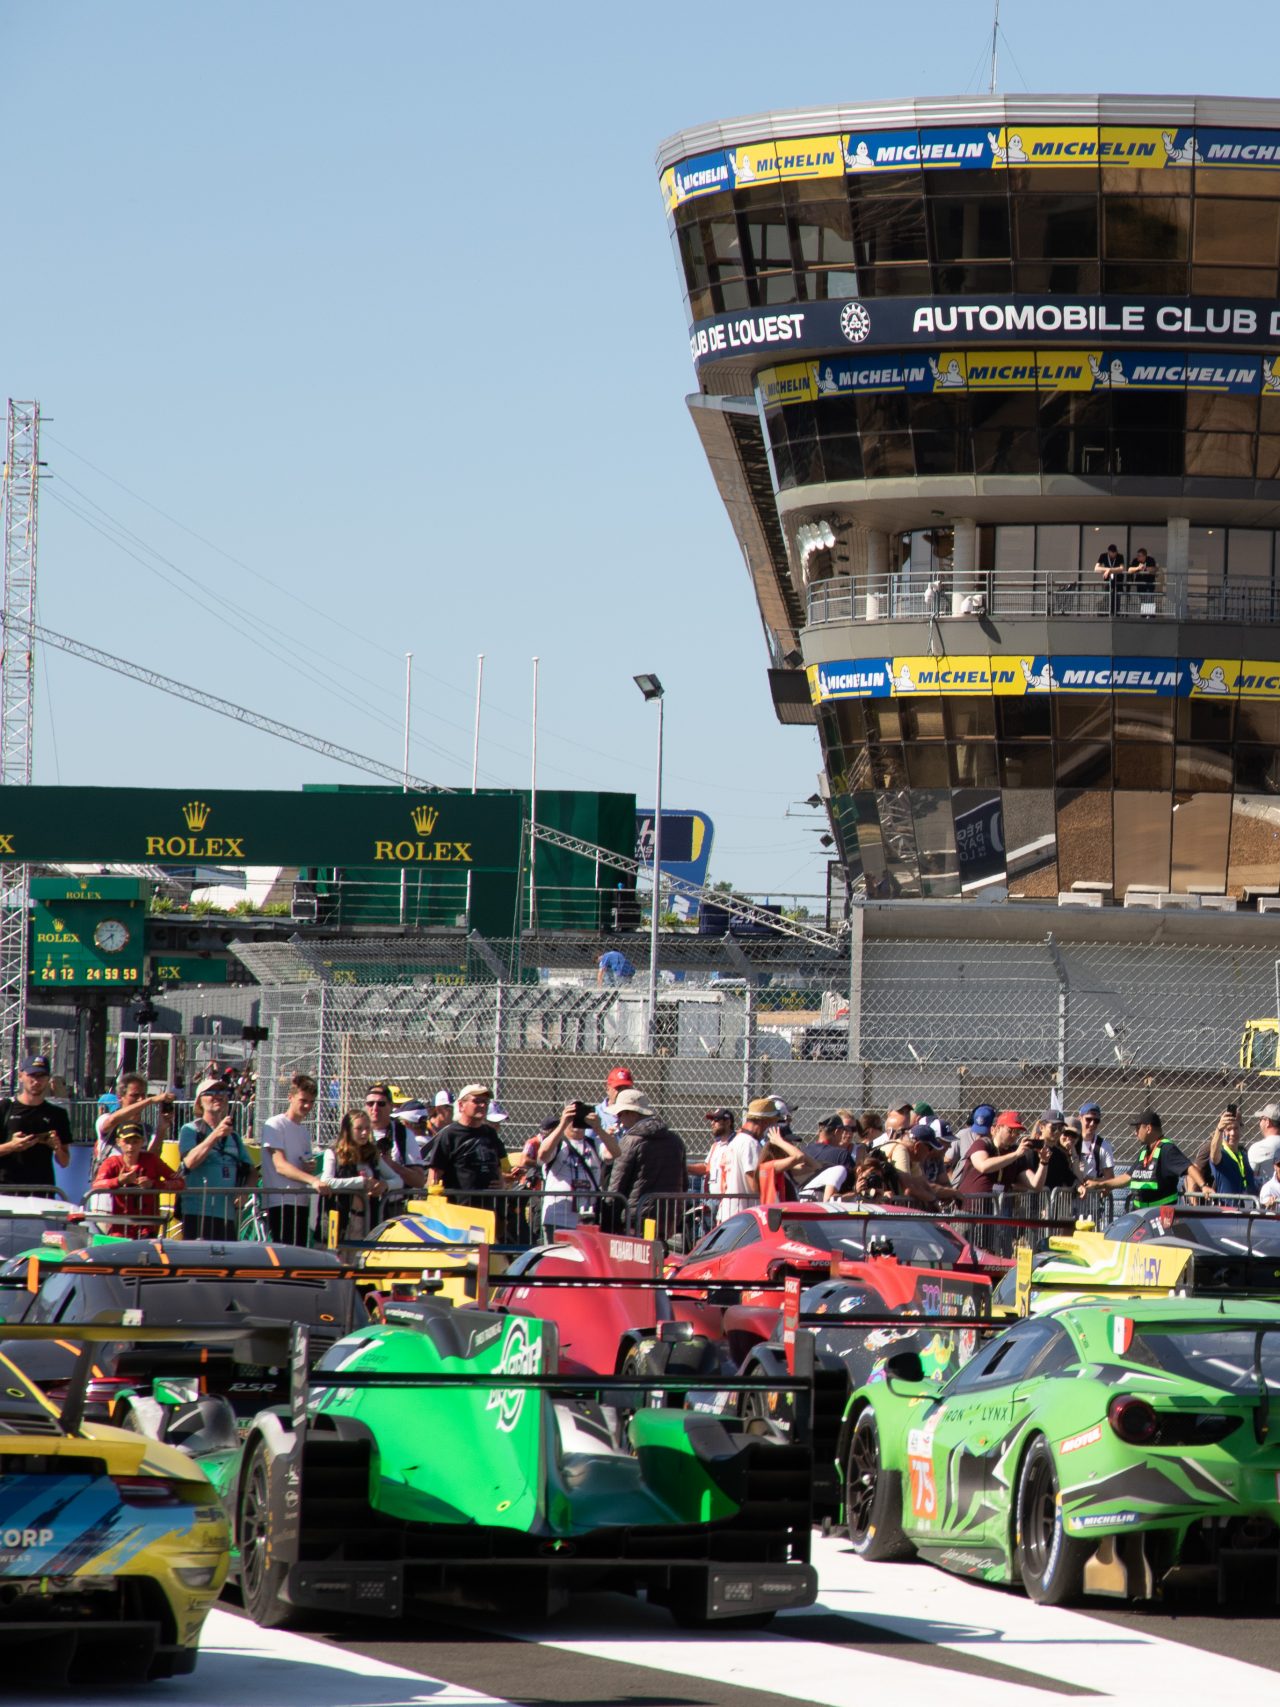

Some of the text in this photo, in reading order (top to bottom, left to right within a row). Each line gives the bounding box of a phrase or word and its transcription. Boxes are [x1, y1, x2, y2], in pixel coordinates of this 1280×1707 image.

[876, 143, 984, 162] MICHELIN
[1031, 142, 1156, 156] MICHELIN
[756, 152, 835, 172] MICHELIN
[683, 165, 728, 187] MICHELIN
[913, 305, 1145, 332] AUTOMOBILE
[1156, 307, 1257, 334] CLUB
[709, 325, 727, 351] DE
[728, 313, 805, 347] L'OUEST
[838, 367, 925, 385] MICHELIN
[968, 365, 1082, 380] MICHELIN
[1132, 366, 1256, 383] MICHELIN
[768, 377, 809, 394] MICHELIN
[827, 671, 884, 690] MICHELIN
[917, 670, 1015, 684] MICHELIN
[1062, 670, 1183, 686] MICHELIN
[146, 837, 245, 857] ROLEX
[374, 842, 473, 862] ROLEX
[66, 891, 102, 900] ROLEX
[37, 933, 79, 943] ROLEX
[41, 968, 137, 980] 24 12 24 59 59
[610, 1240, 651, 1264] RICHARD MILLE
[59, 1266, 453, 1280] PORSCHE
[229, 1383, 277, 1392] RSR
[944, 1407, 1009, 1422] IRON LYNX
[1062, 1427, 1101, 1453] MOTUL
[913, 1464, 936, 1514] 75
[1084, 1513, 1136, 1526] MICHELIN
